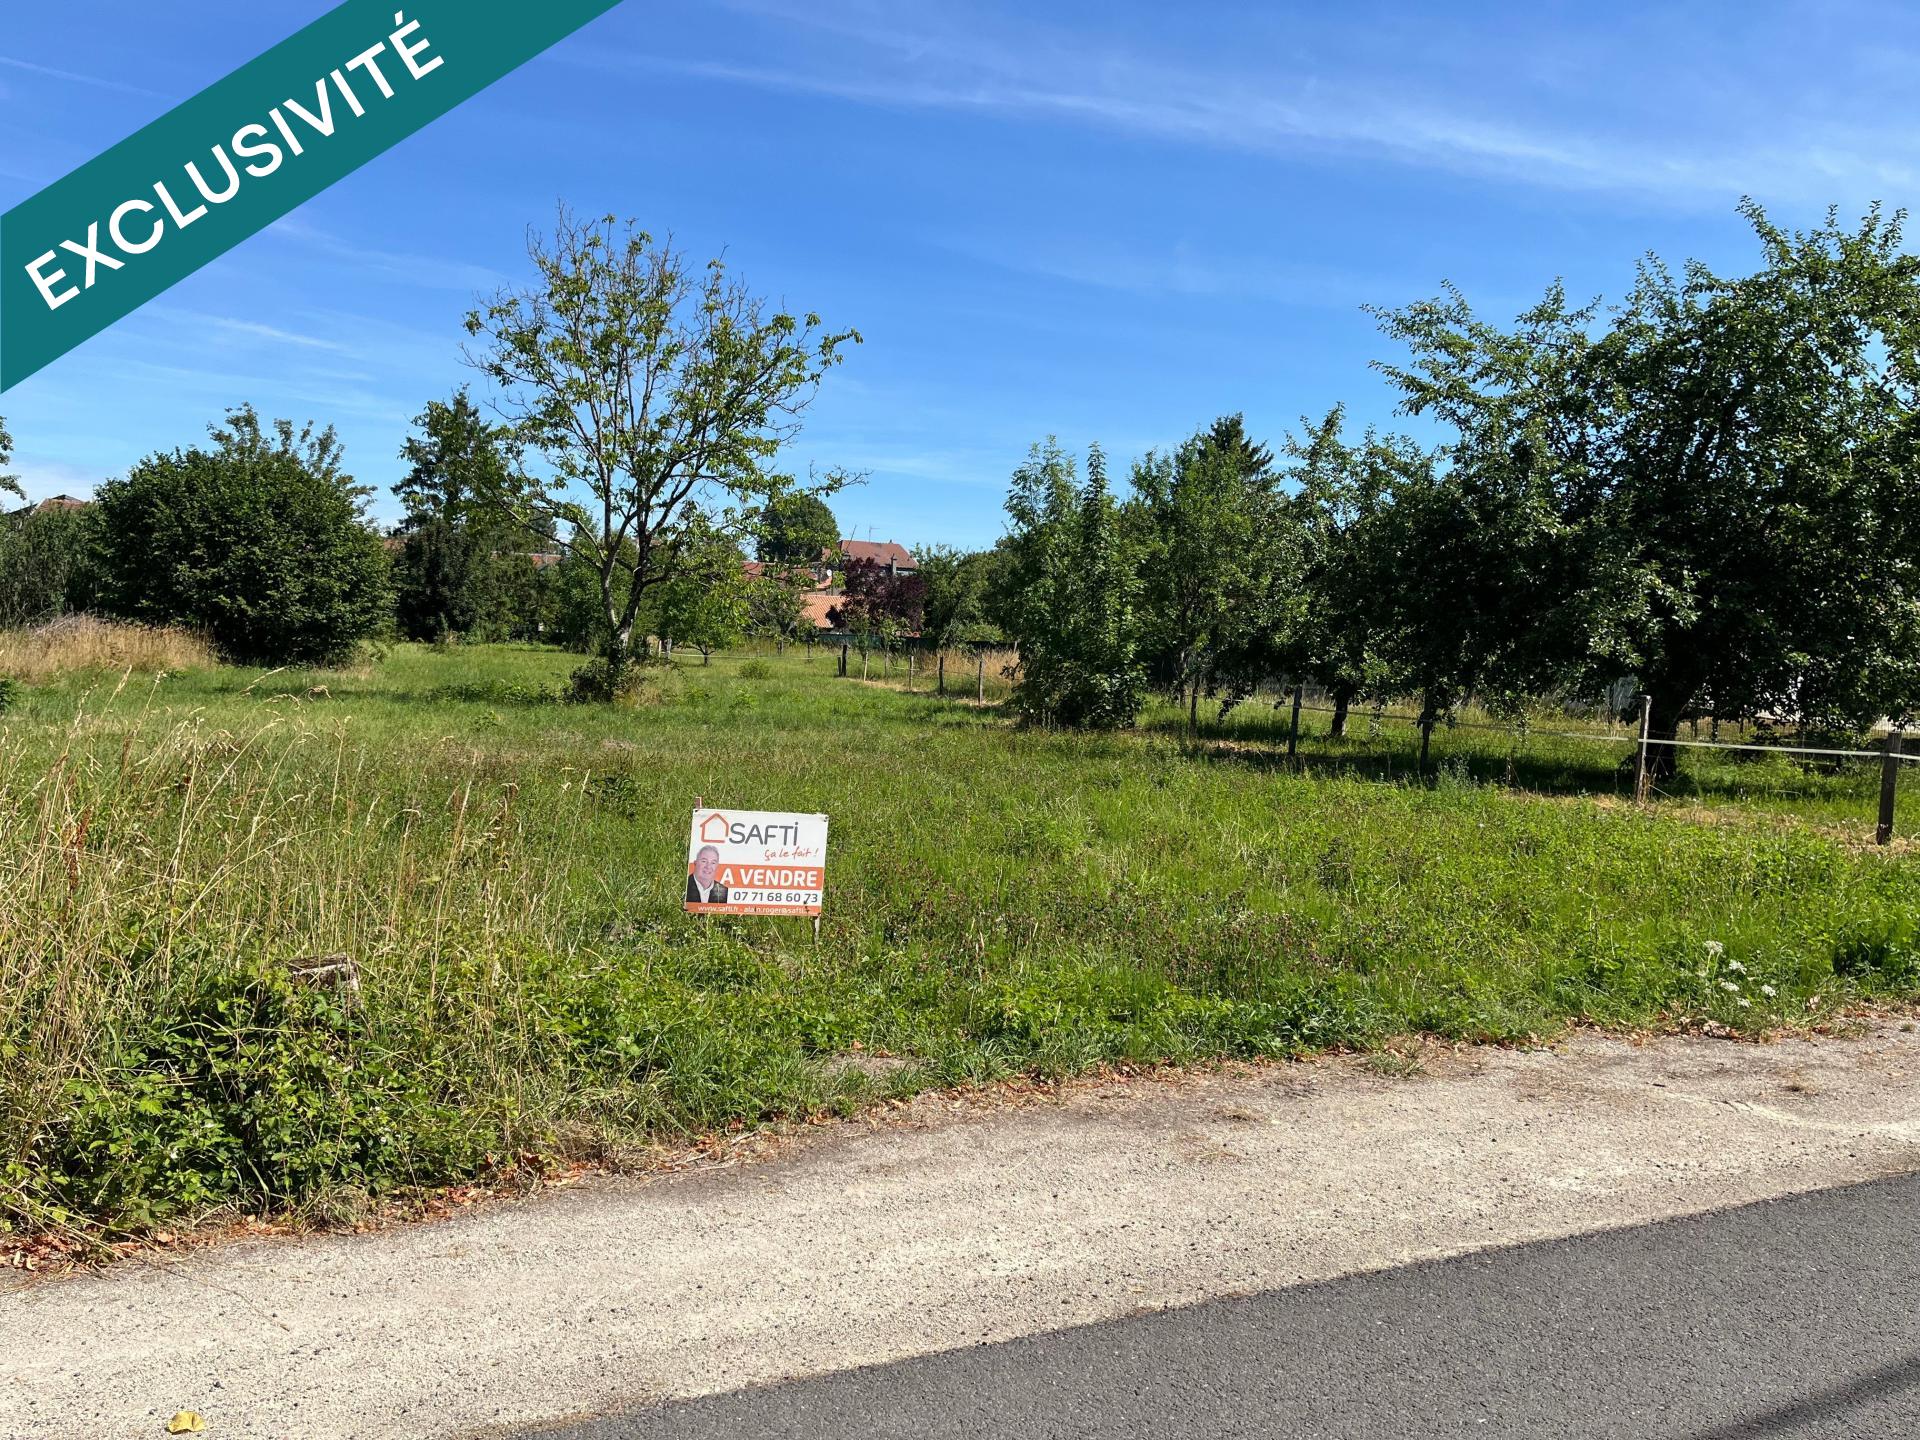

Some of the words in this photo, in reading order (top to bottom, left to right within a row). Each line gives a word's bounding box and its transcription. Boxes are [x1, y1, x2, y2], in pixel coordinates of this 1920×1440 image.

[791, 846, 811, 860] fait
[720, 868, 735, 885] A
[740, 868, 818, 887] VENDRE
[733, 891, 748, 901] 07
[752, 892, 763, 901] 71
[767, 892, 782, 902] 68
[786, 893, 801, 902] 60
[805, 893, 818, 903] 73
